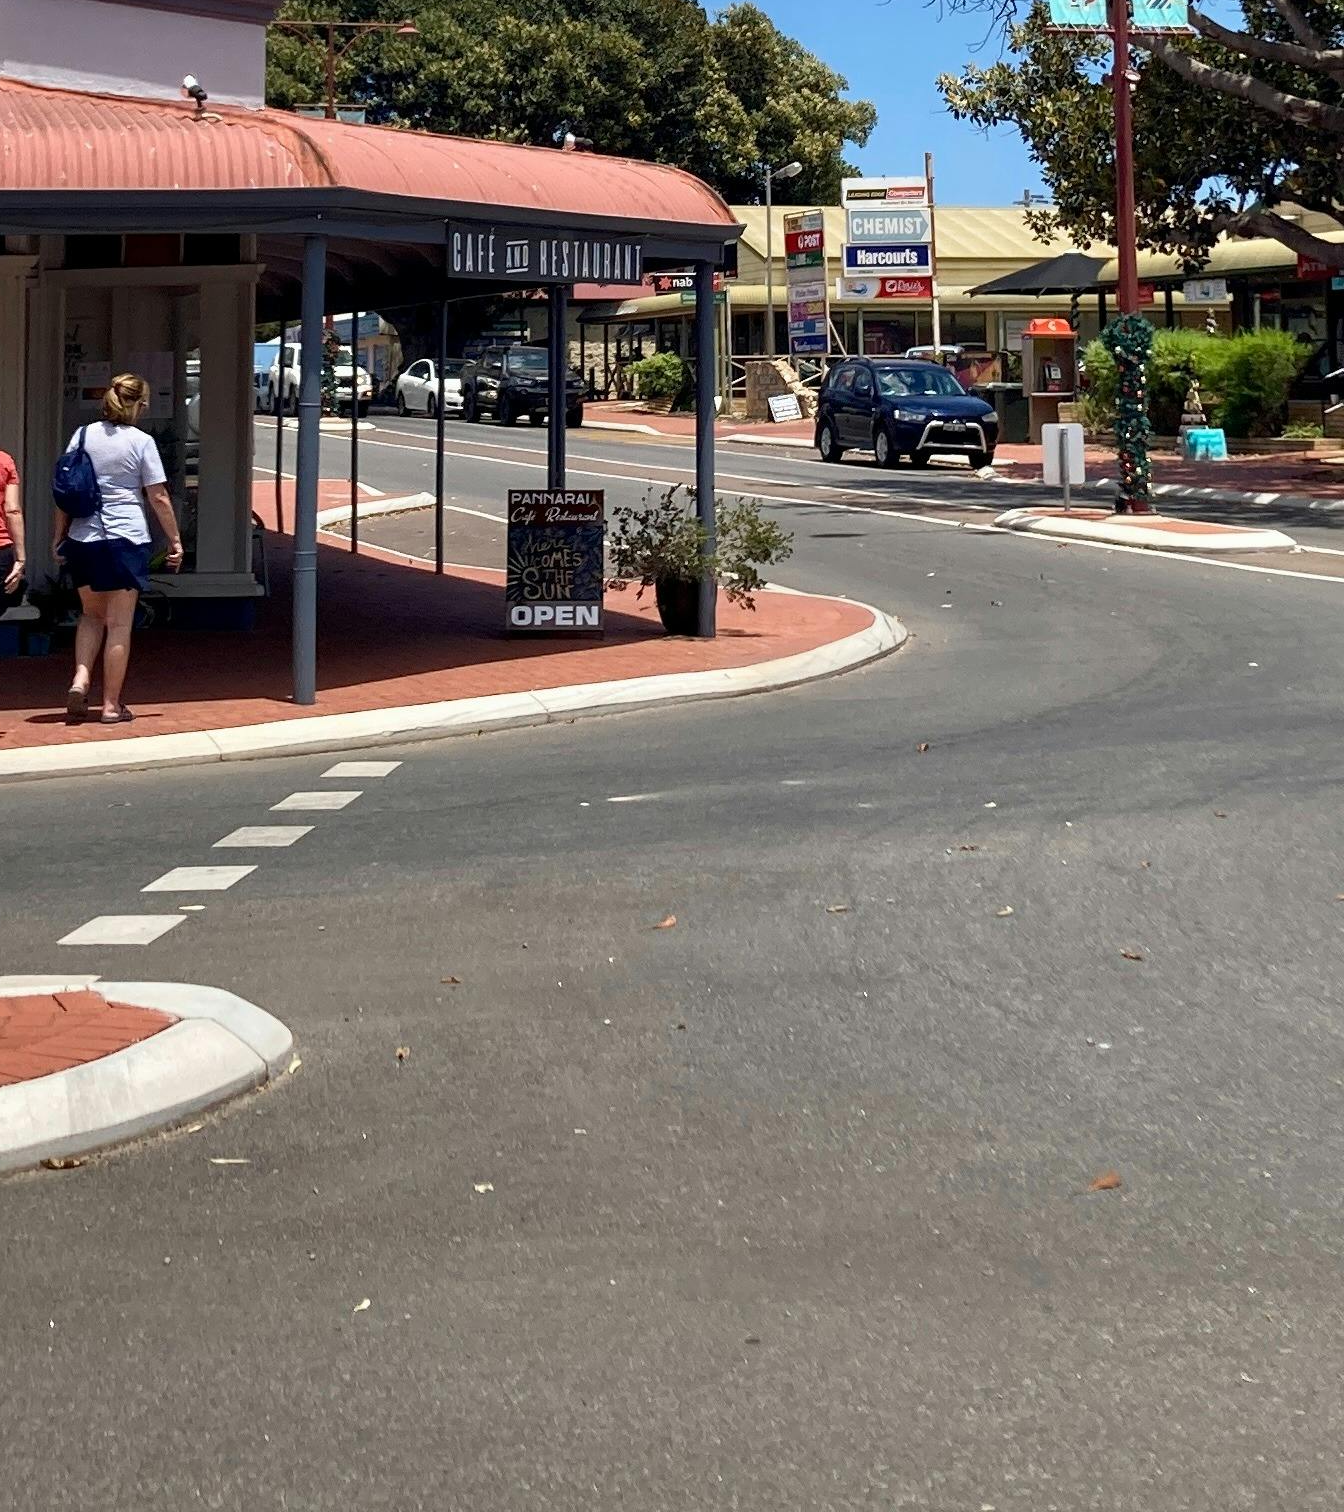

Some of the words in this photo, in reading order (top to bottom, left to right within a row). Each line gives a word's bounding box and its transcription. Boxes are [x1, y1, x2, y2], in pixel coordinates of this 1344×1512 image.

[852, 217, 923, 235] CHEMIST
[453, 227, 495, 273] CAFÉ
[506, 244, 529, 268] AND
[540, 240, 642, 281] RESTAURANT
[856, 248, 918, 265] Harcourts
[672, 277, 693, 287] nab
[511, 492, 590, 505] PANNARAI
[511, 605, 599, 626] OPEN
